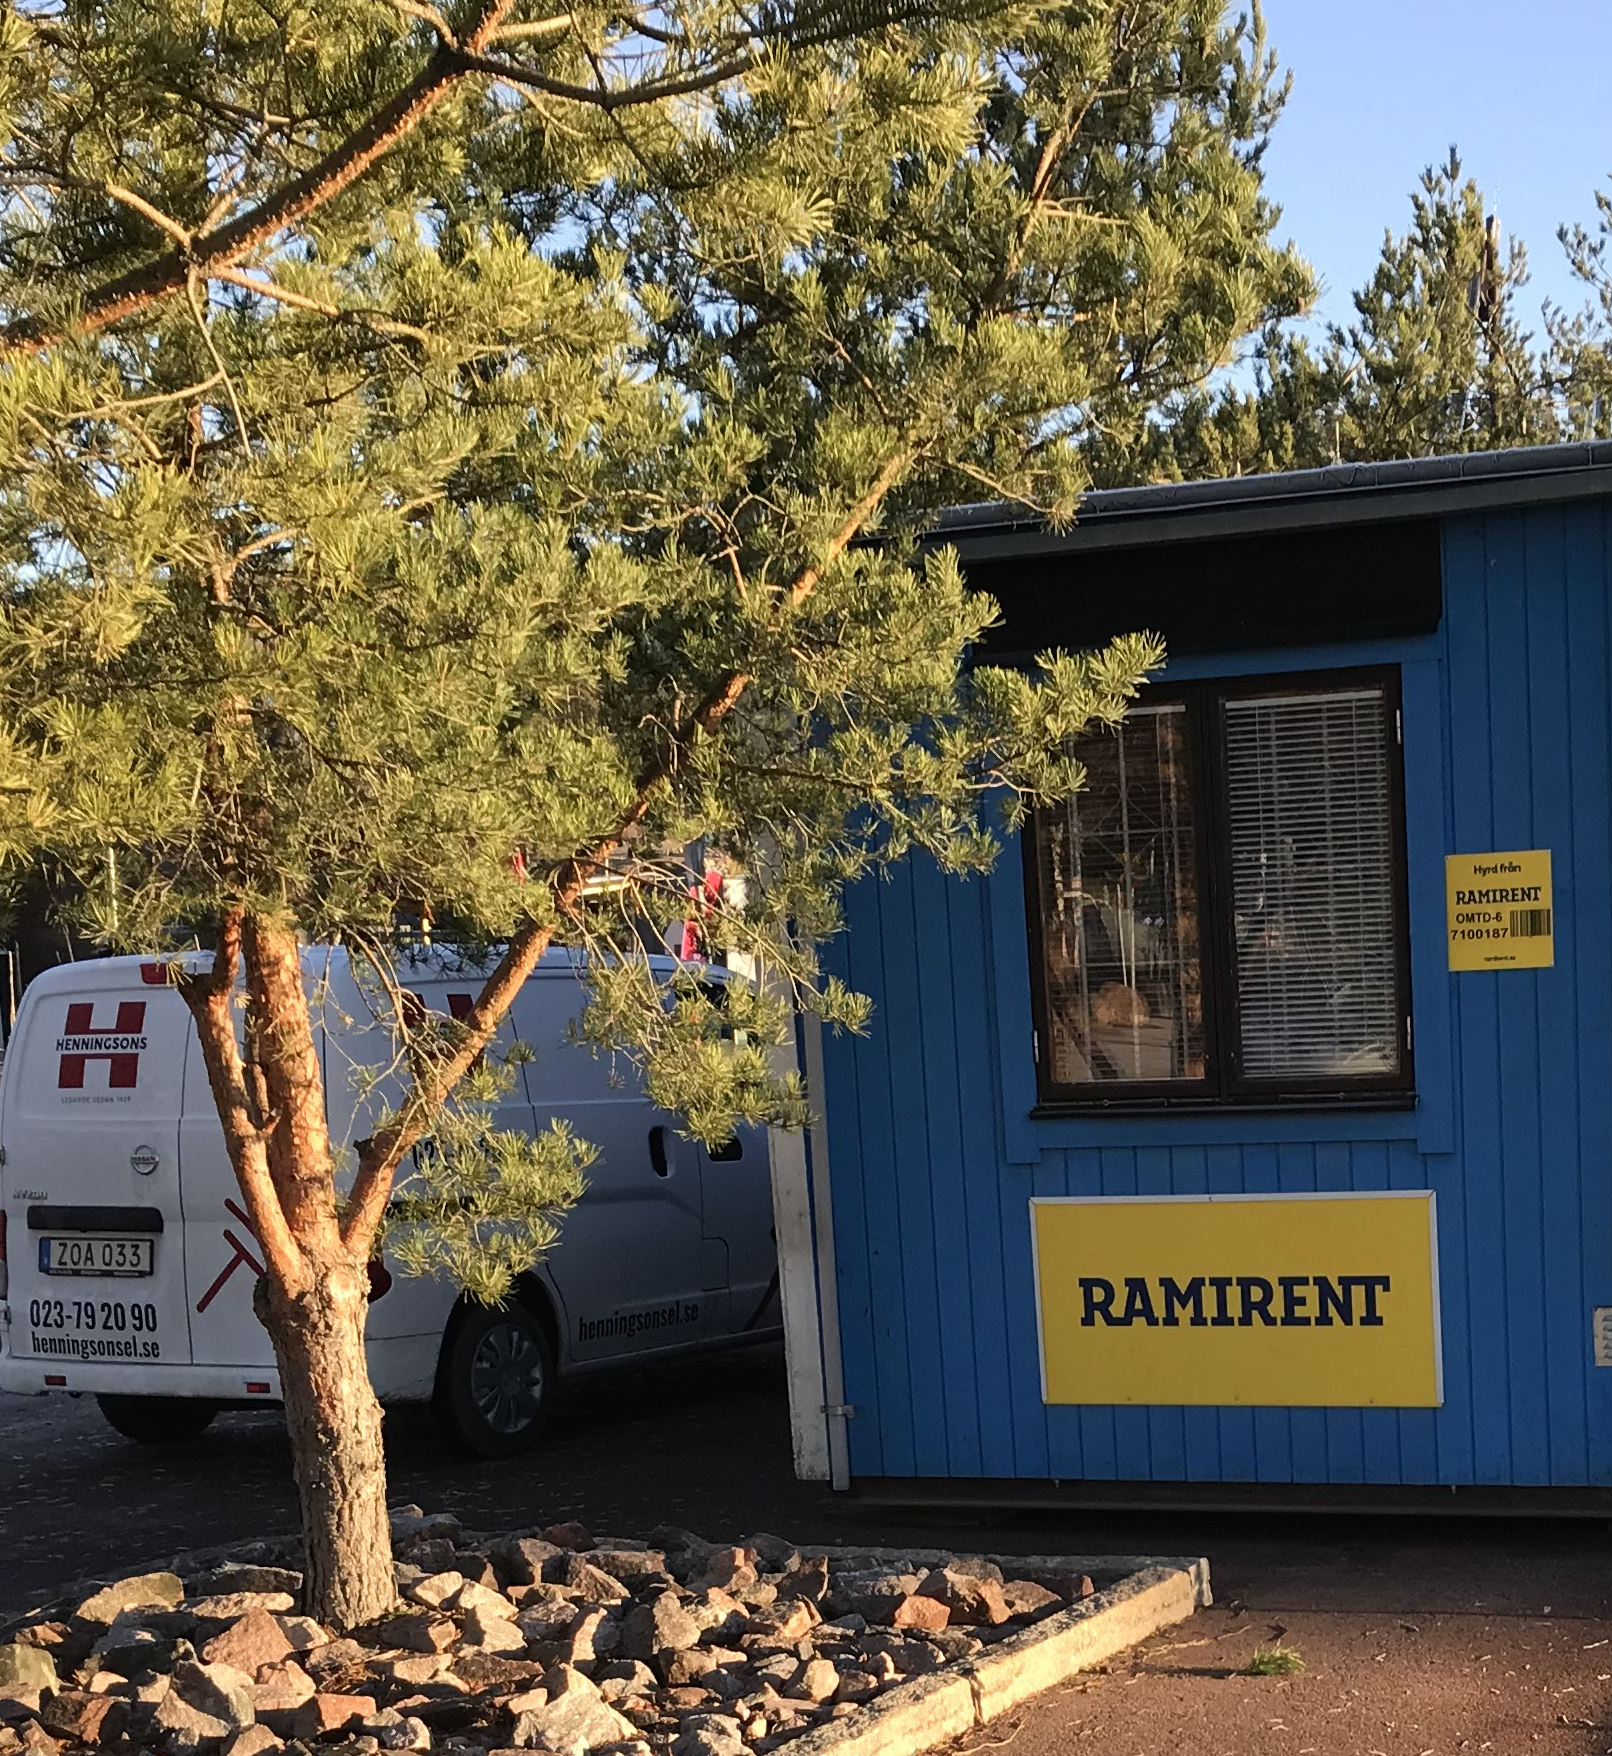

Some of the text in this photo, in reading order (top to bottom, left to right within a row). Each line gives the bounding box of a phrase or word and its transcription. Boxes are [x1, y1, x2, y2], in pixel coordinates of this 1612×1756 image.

[1473, 861, 1522, 877] Hyrd från
[1455, 886, 1542, 906] RAMIRENT
[1455, 911, 1503, 925] OMTD-6
[1450, 927, 1509, 940] 7100187
[55, 1036, 148, 1051] HENNINGSONS
[57, 1242, 142, 1268] ZOA 033
[1078, 1275, 1391, 1327] RAMIRENT
[30, 1299, 158, 1333] 023-79 20 90
[578, 1299, 699, 1342] henningsonsel.se
[31, 1331, 161, 1360] henningsonsel.se
